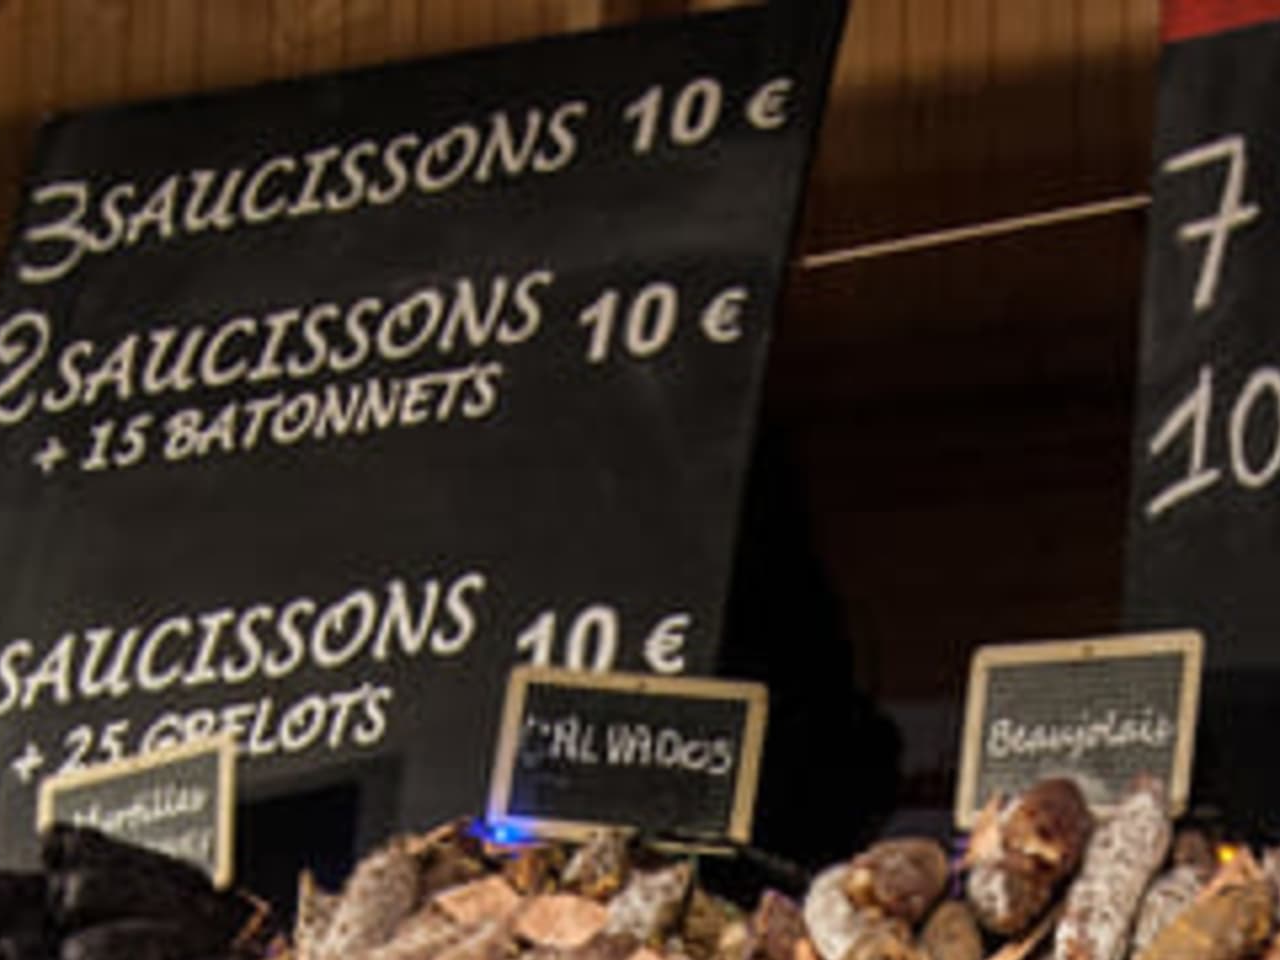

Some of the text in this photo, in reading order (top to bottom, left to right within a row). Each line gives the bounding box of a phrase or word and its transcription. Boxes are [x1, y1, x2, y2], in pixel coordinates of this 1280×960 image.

[17, 77, 795, 283] 3 SAUCISSONS 10 €
[1161, 135, 1260, 311] 7
[42, 270, 557, 413] SAUCISSONS
[577, 282, 678, 364] 10
[702, 289, 749, 344] €
[32, 363, 505, 478] + 15 BATONNETS
[515, 604, 619, 674] 10
[643, 613, 691, 674] €
[987, 716, 1173, 771] Beaujolais
